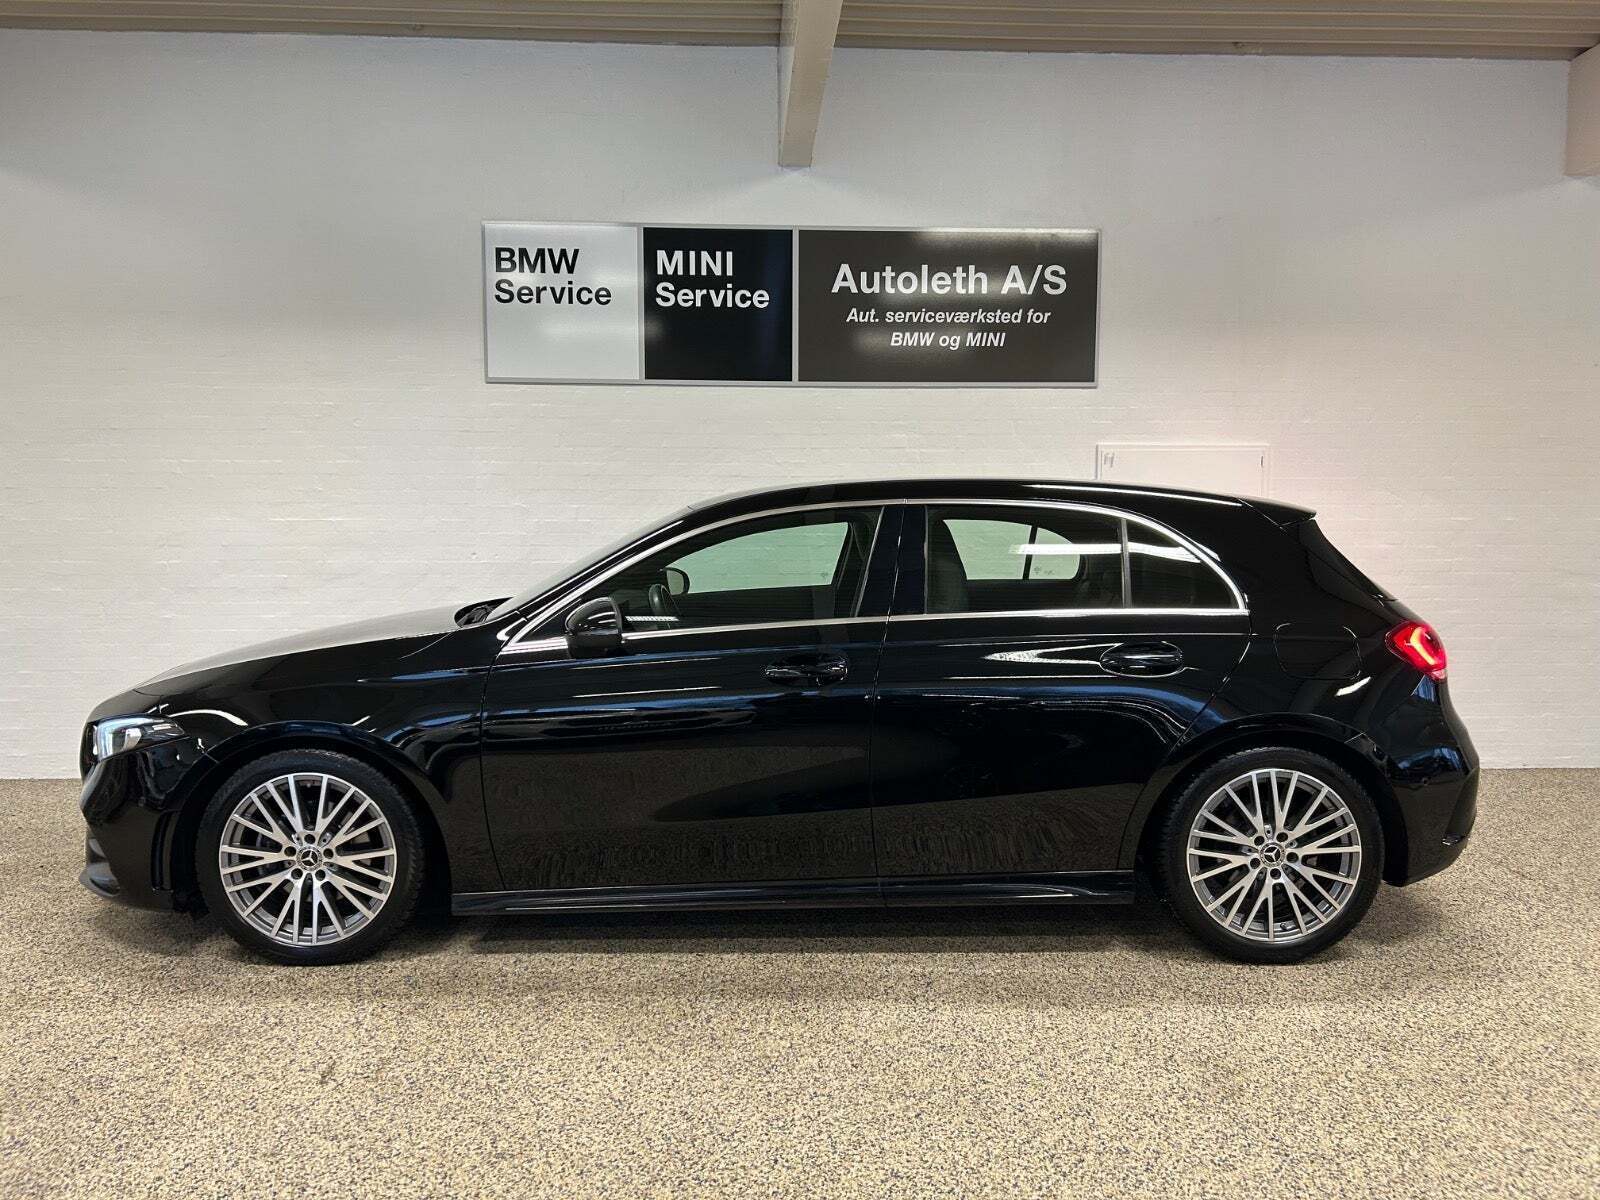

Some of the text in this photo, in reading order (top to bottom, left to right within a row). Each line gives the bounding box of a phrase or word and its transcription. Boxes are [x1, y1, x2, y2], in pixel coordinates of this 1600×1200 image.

[494, 247, 580, 274] BMW
[656, 250, 733, 276] MINI
[494, 279, 612, 306] Service
[831, 263, 1067, 295] Autoleth A/S
[655, 282, 770, 309] Service
[846, 308, 1051, 323] Aut. serviceværksted for
[890, 332, 1006, 350] BMW og MINI
